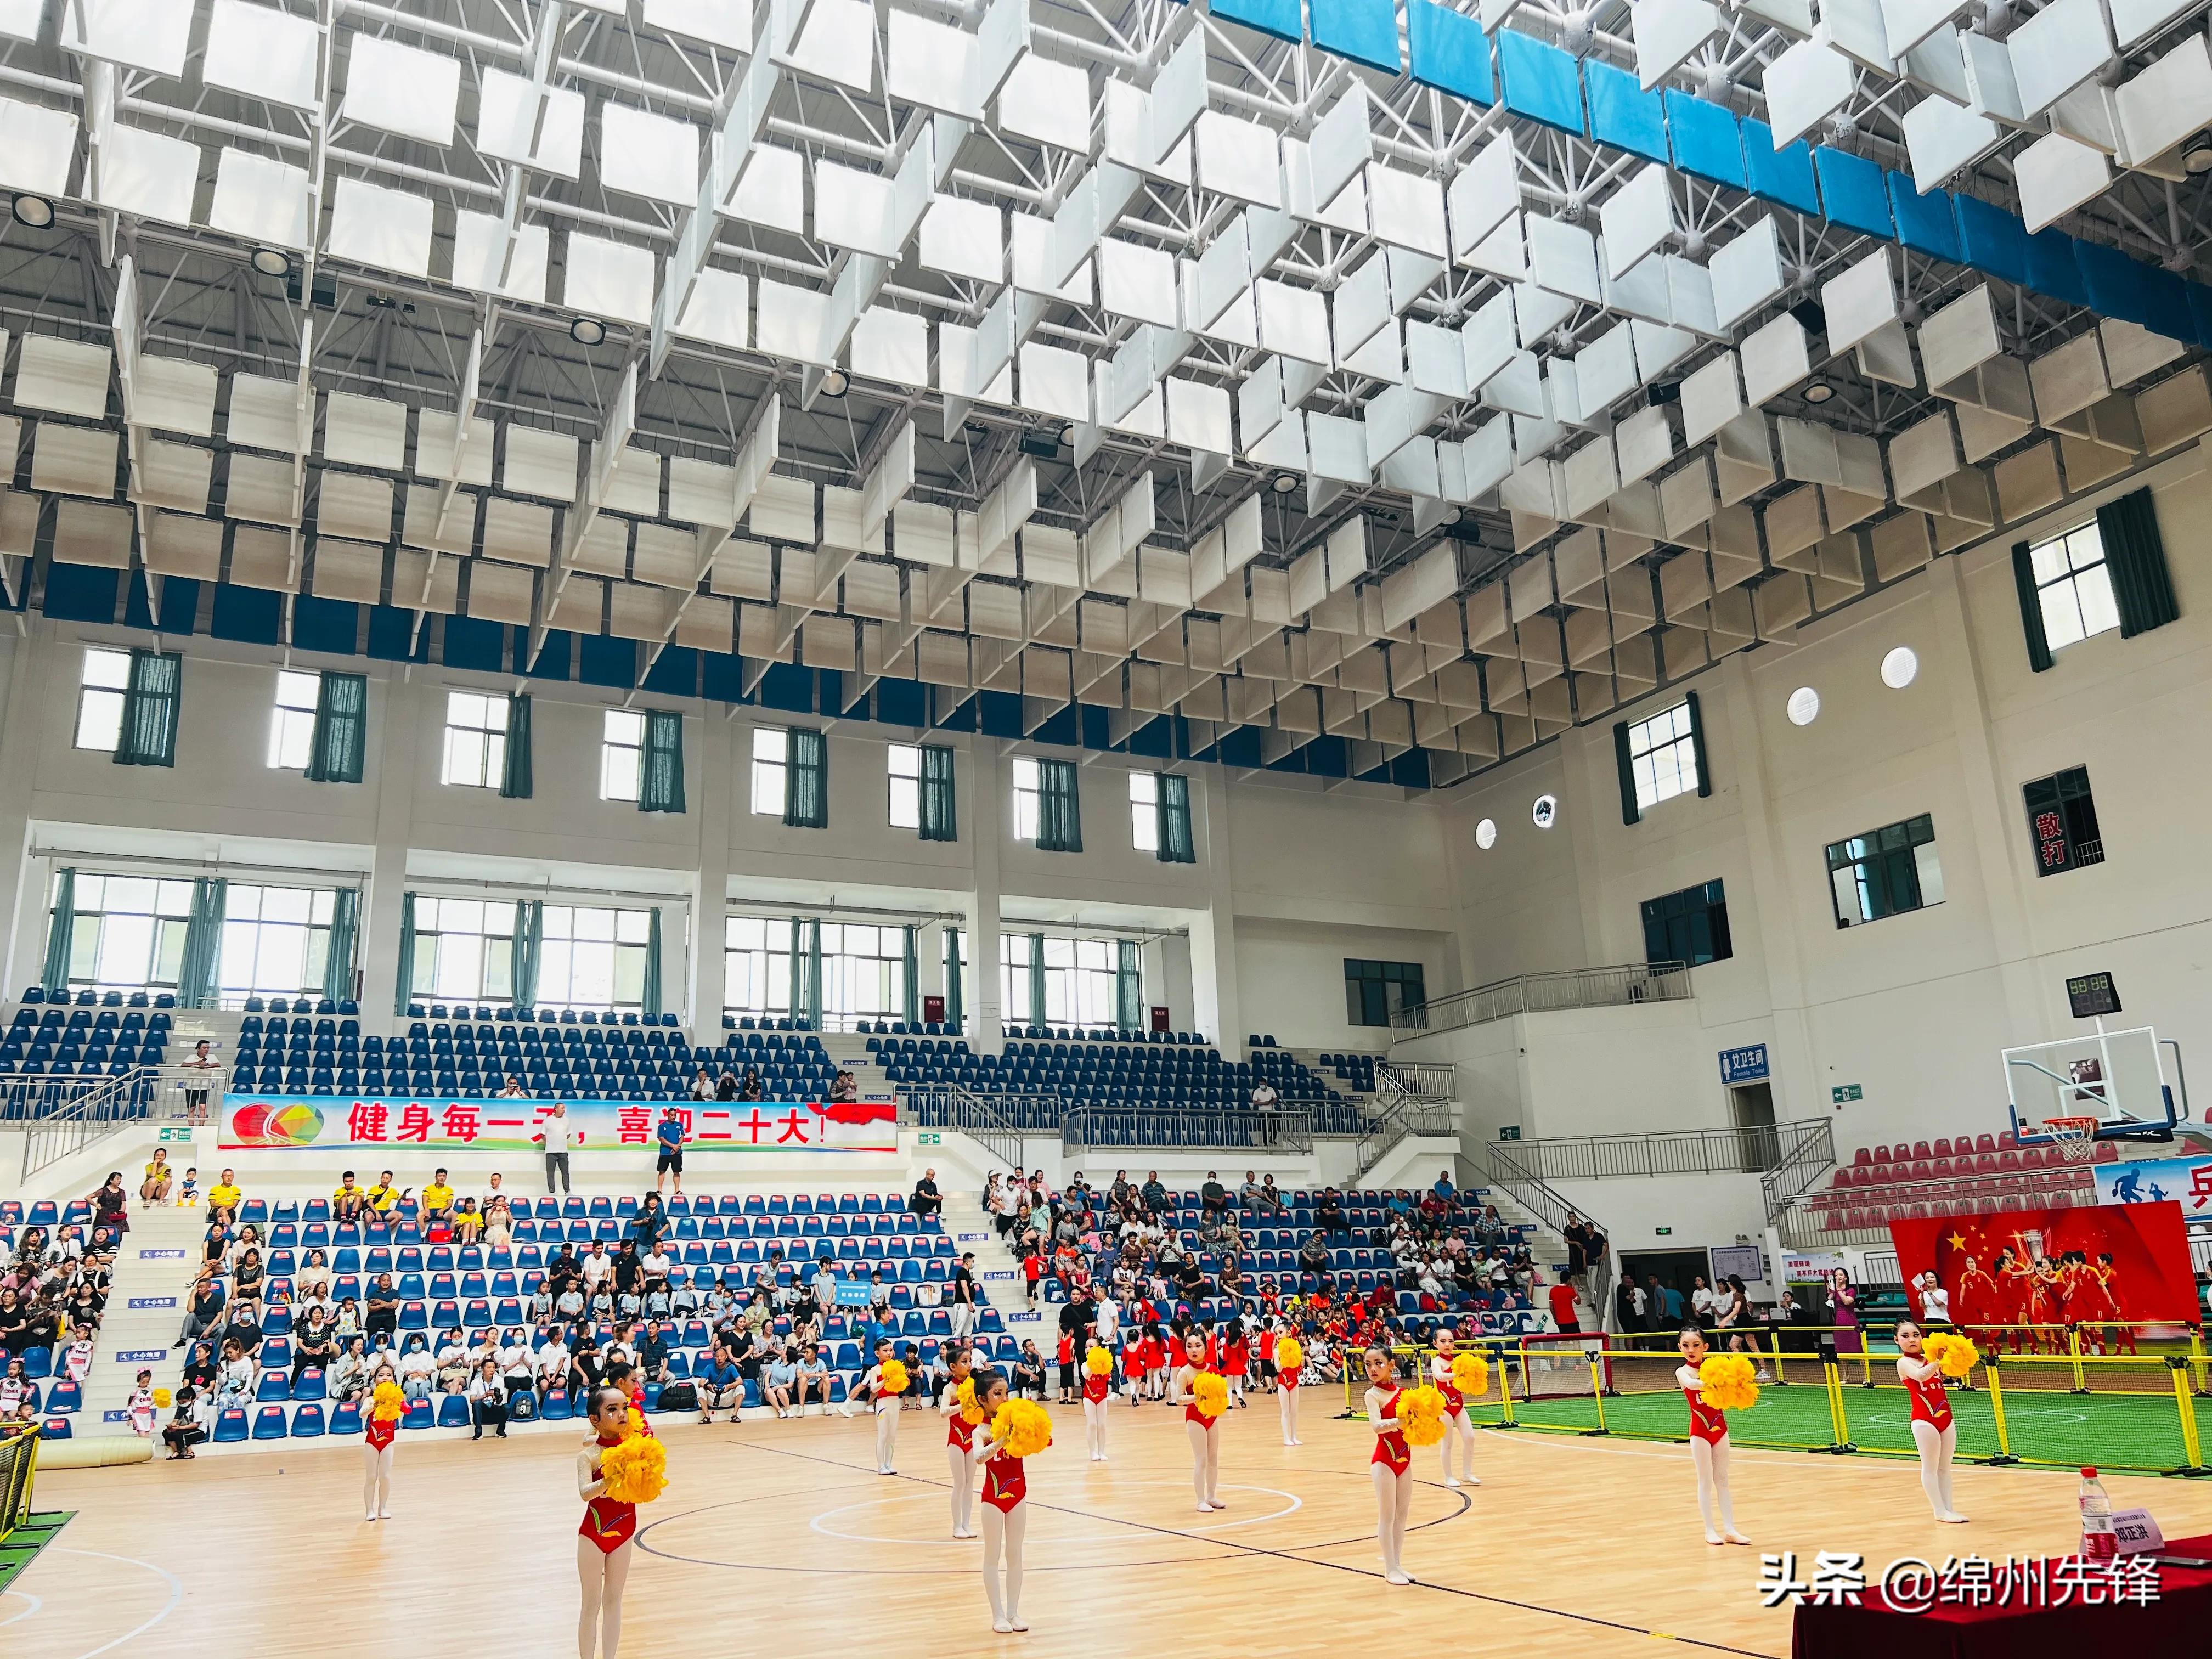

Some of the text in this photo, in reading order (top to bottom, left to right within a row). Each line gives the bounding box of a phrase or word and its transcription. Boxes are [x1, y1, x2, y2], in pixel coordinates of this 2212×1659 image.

[2036, 812, 2065, 866] 散打
[1732, 1049, 1764, 1070] 女卫生间
